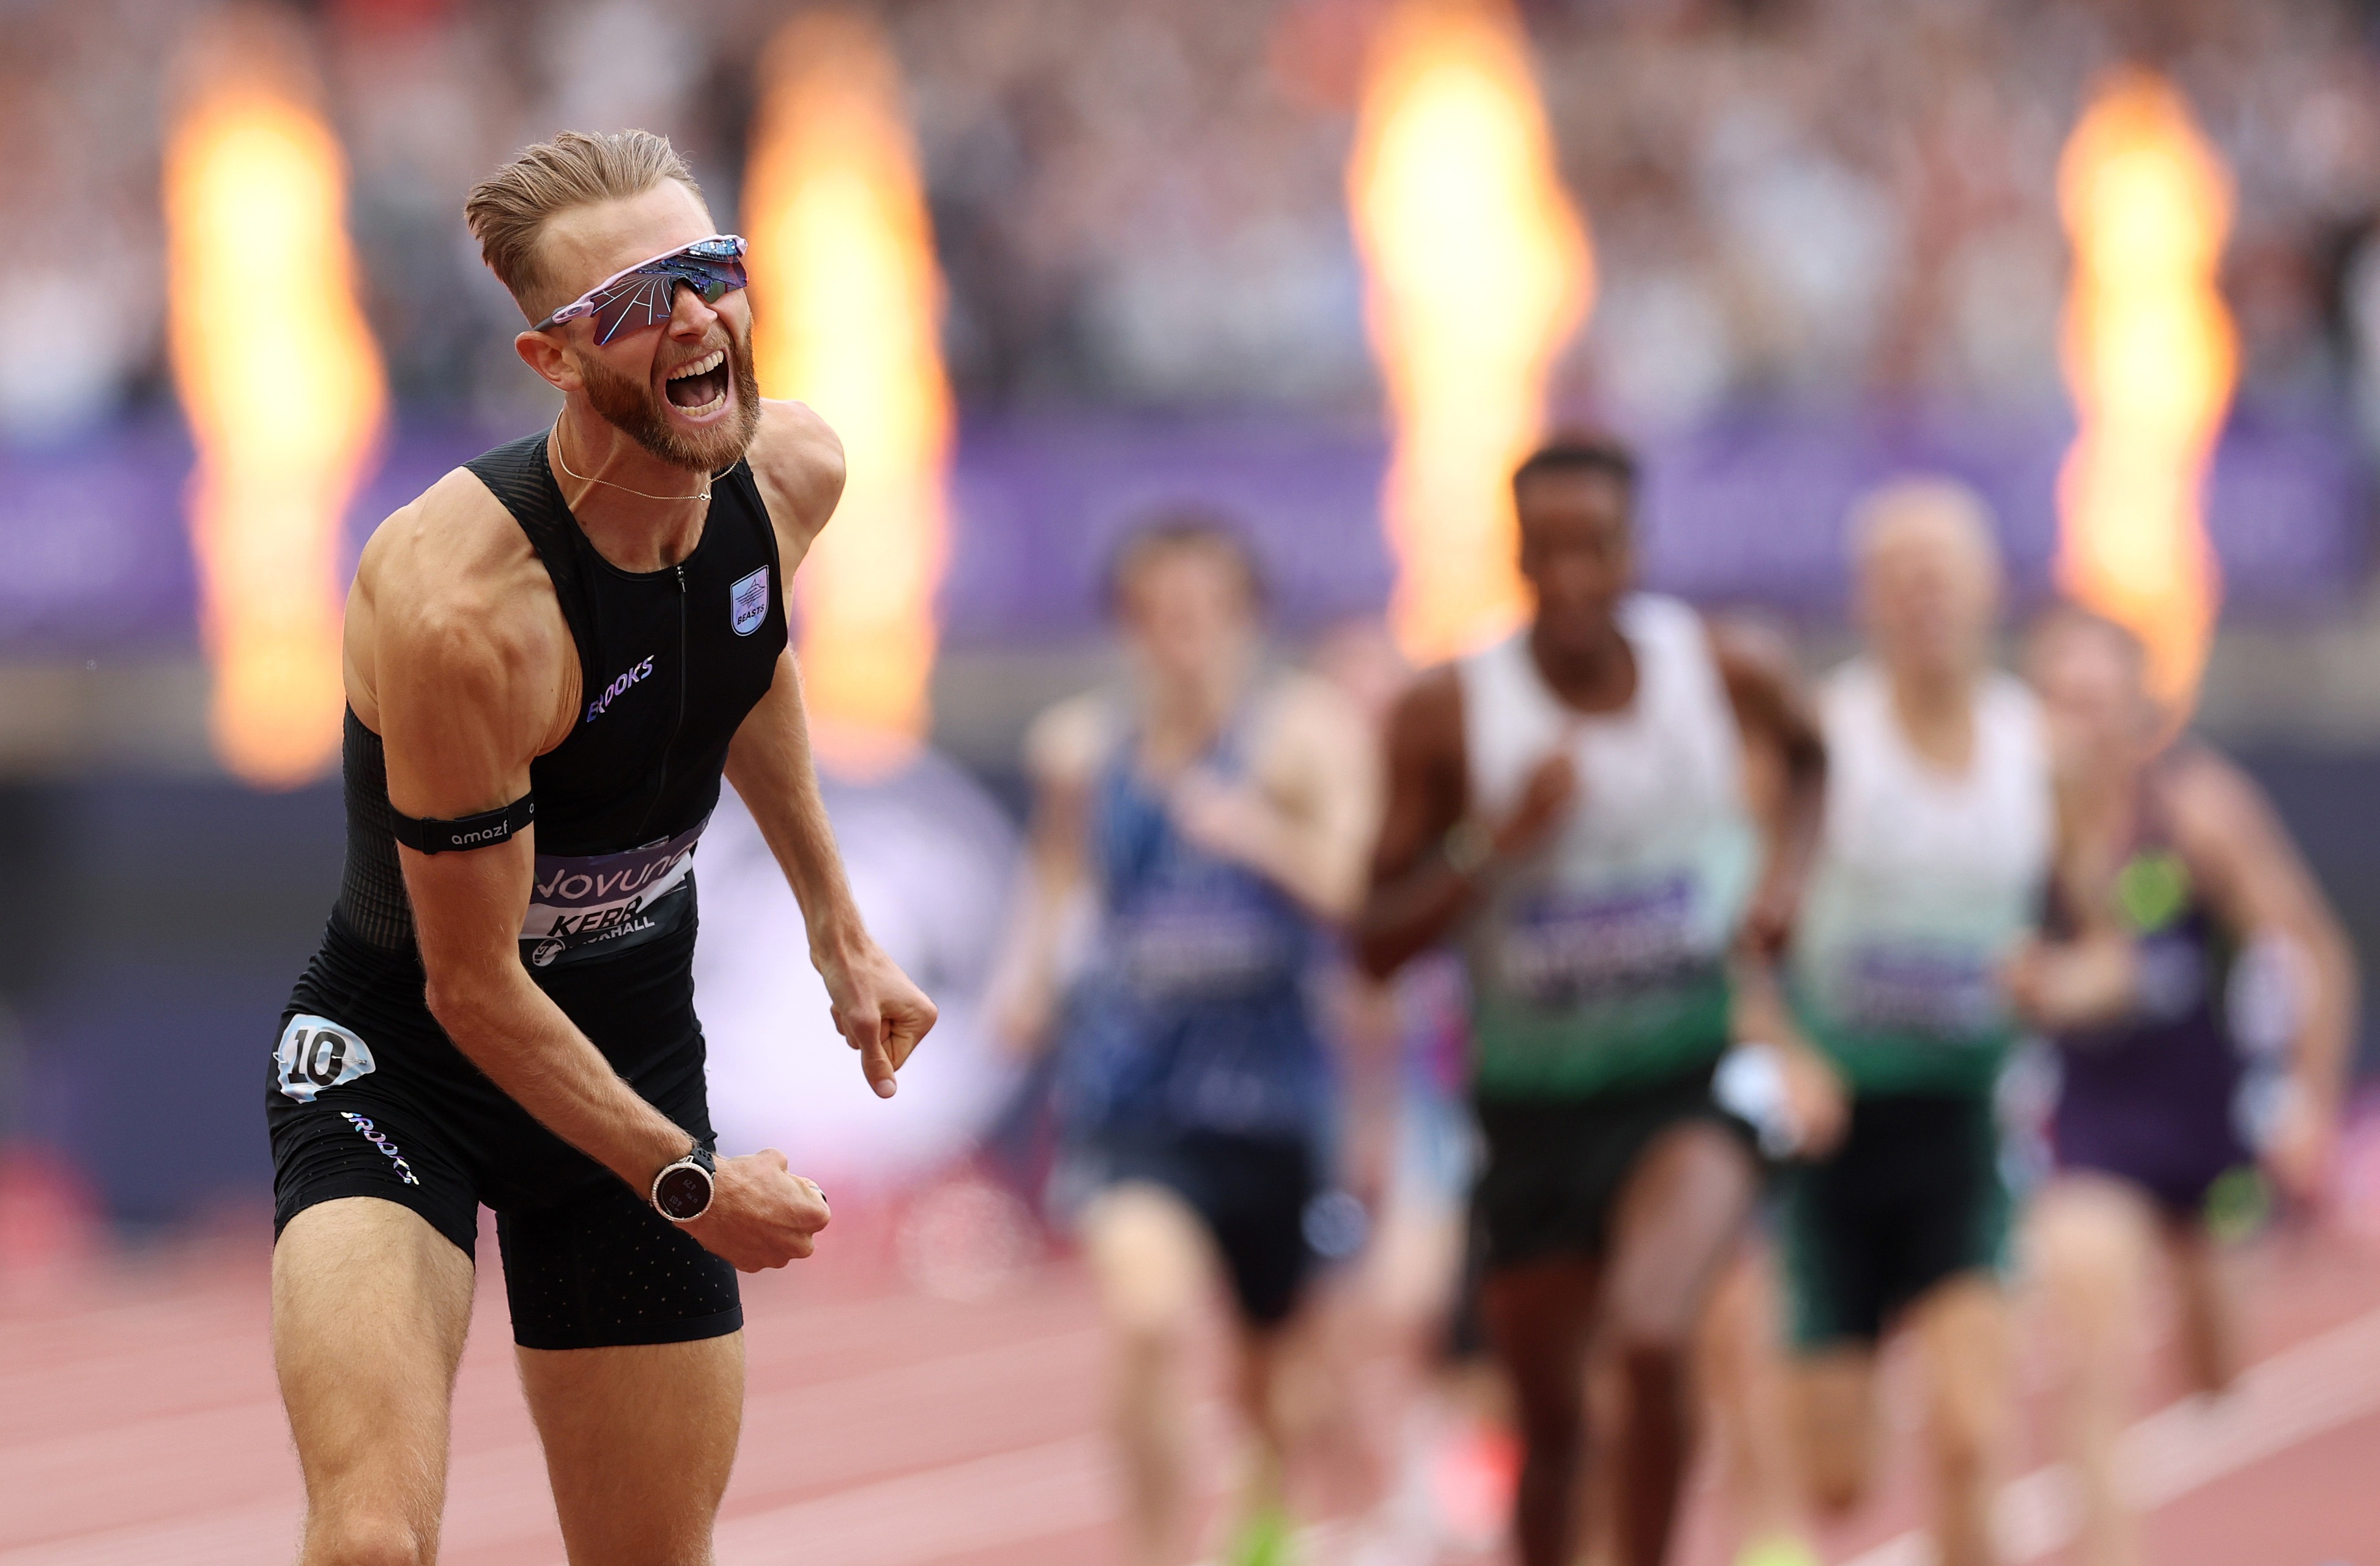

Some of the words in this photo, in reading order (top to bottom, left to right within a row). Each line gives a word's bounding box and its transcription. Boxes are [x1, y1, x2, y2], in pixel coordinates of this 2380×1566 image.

[737, 604, 765, 625] BEASTS
[547, 896, 642, 936] KERR
[569, 917, 655, 948] HALL
[287, 1029, 346, 1086] 10
